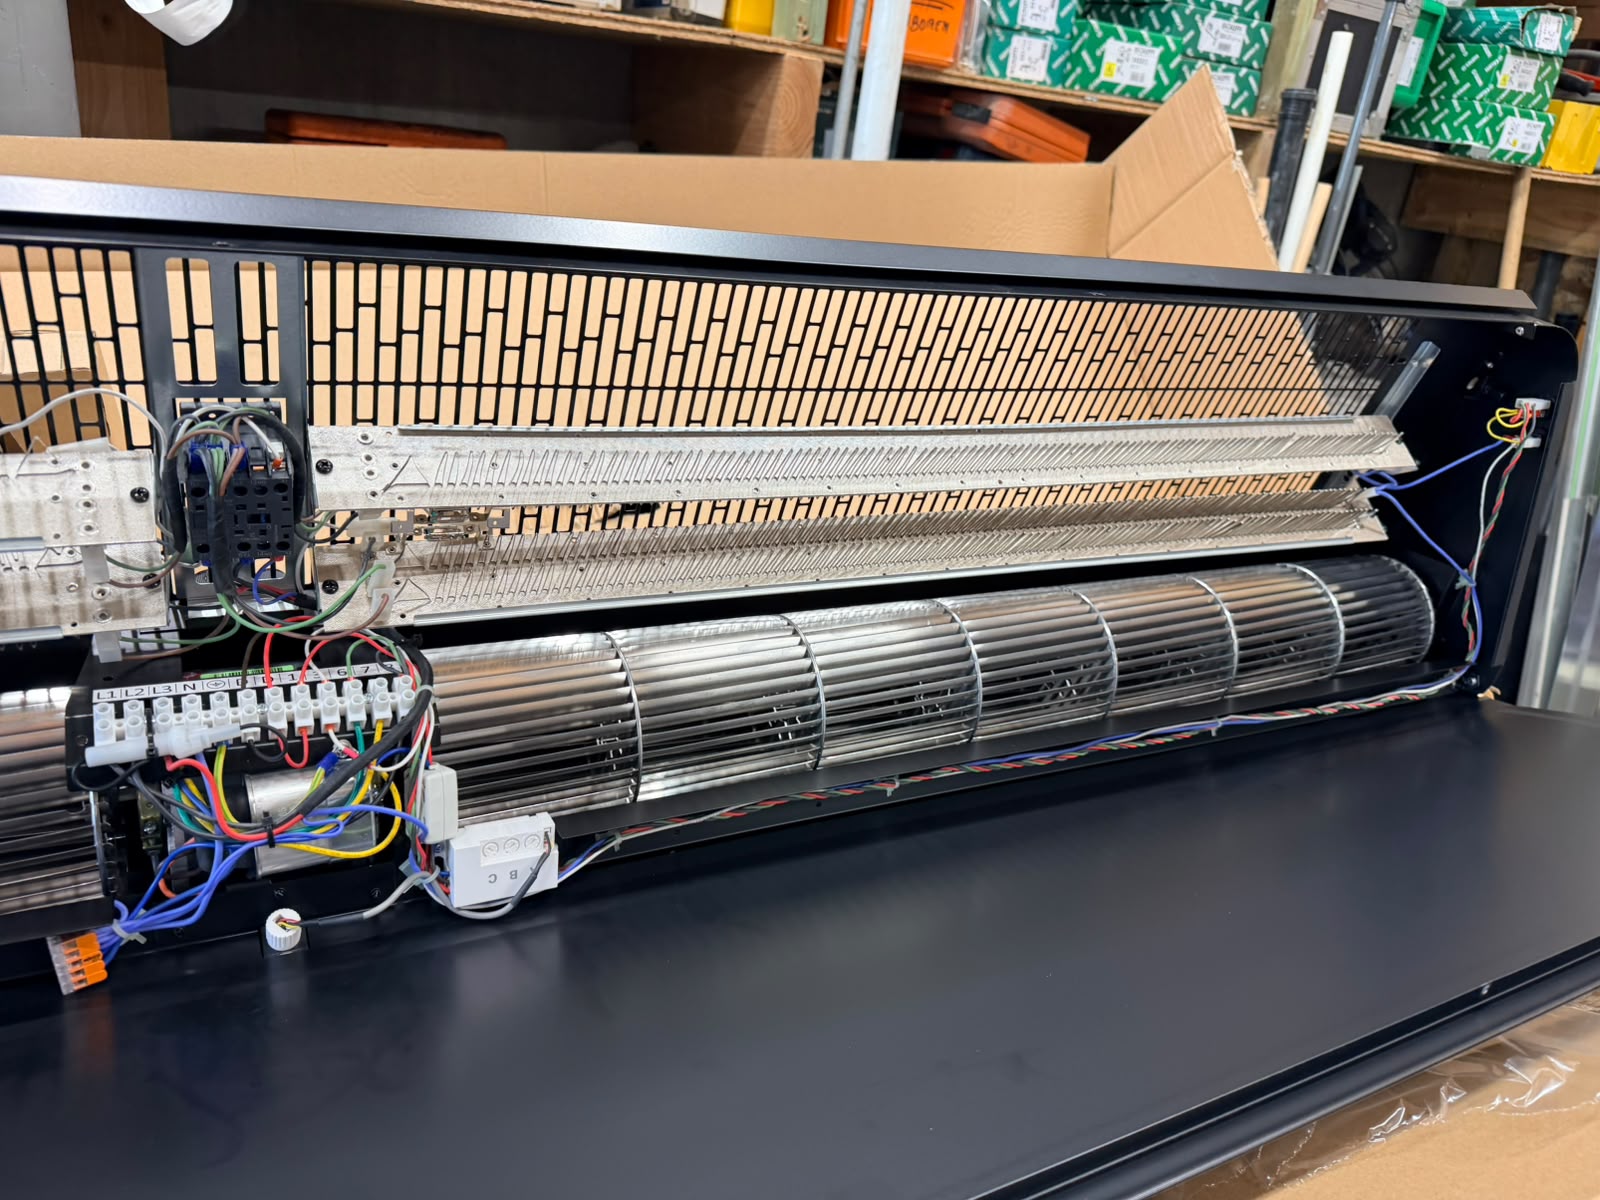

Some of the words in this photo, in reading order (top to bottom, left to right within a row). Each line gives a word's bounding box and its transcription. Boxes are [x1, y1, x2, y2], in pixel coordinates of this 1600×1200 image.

[97, 690, 117, 700] L1
[125, 688, 145, 698] L2
[152, 685, 173, 695] L3
[183, 683, 196, 692] N
[287, 673, 298, 681] 1
[337, 668, 347, 677] 6
[360, 666, 371, 674] 7
[488, 873, 498, 884] C
[509, 869, 518, 880] B
